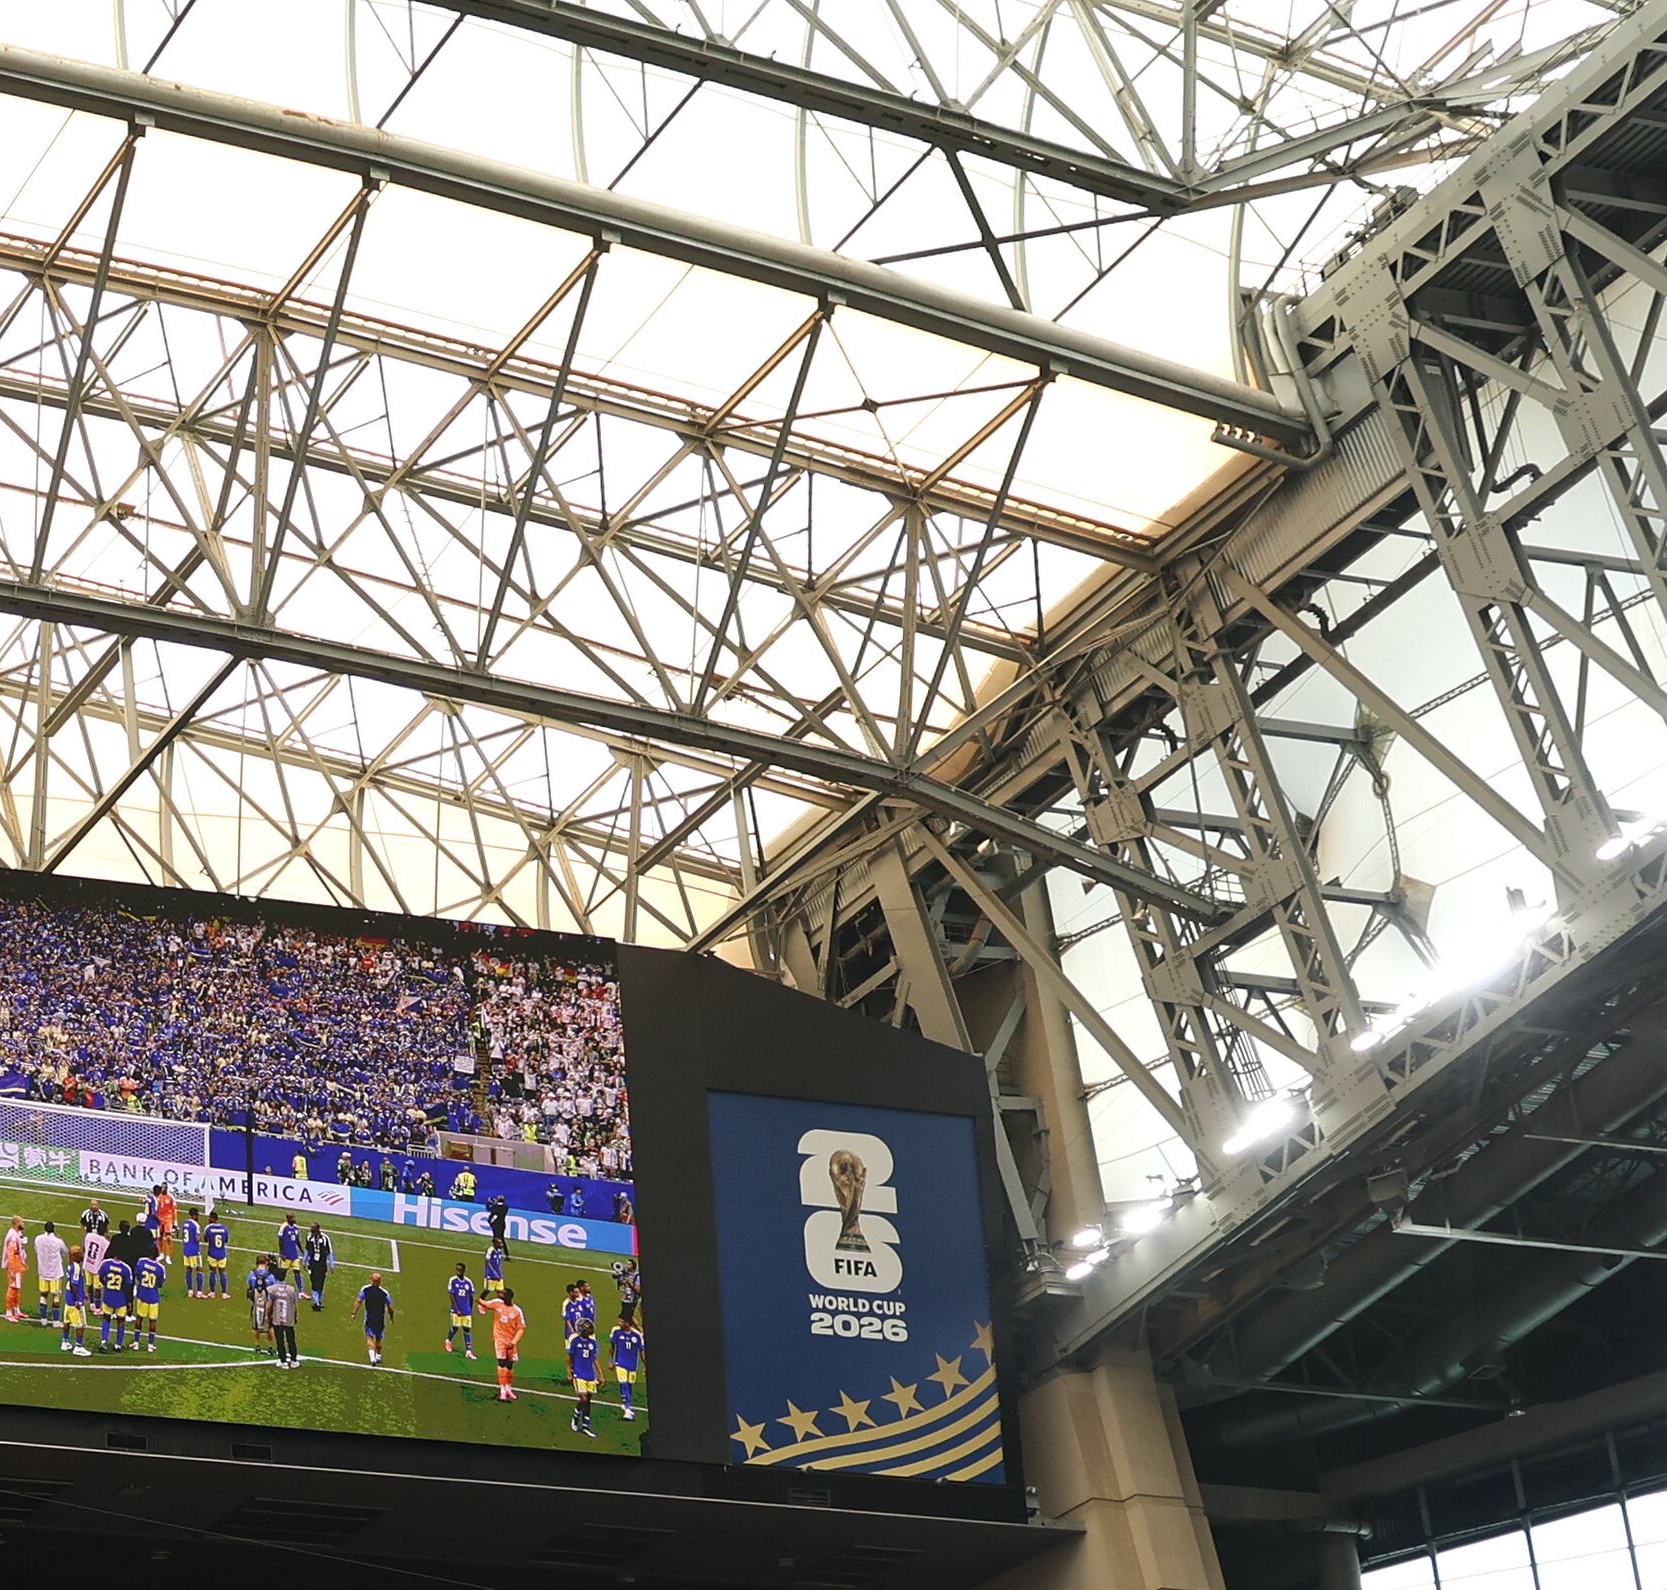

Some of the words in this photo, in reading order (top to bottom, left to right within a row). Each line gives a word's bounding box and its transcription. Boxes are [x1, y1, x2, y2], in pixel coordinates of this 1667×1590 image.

[89, 1158, 155, 1185] BANK
[164, 1168, 193, 1189] OF
[393, 1193, 588, 1250] Hisense
[833, 1257, 878, 1278] FIFA
[808, 1293, 870, 1314] WORLD
[873, 1300, 907, 1316] CUP
[810, 1311, 908, 1342] 2026
